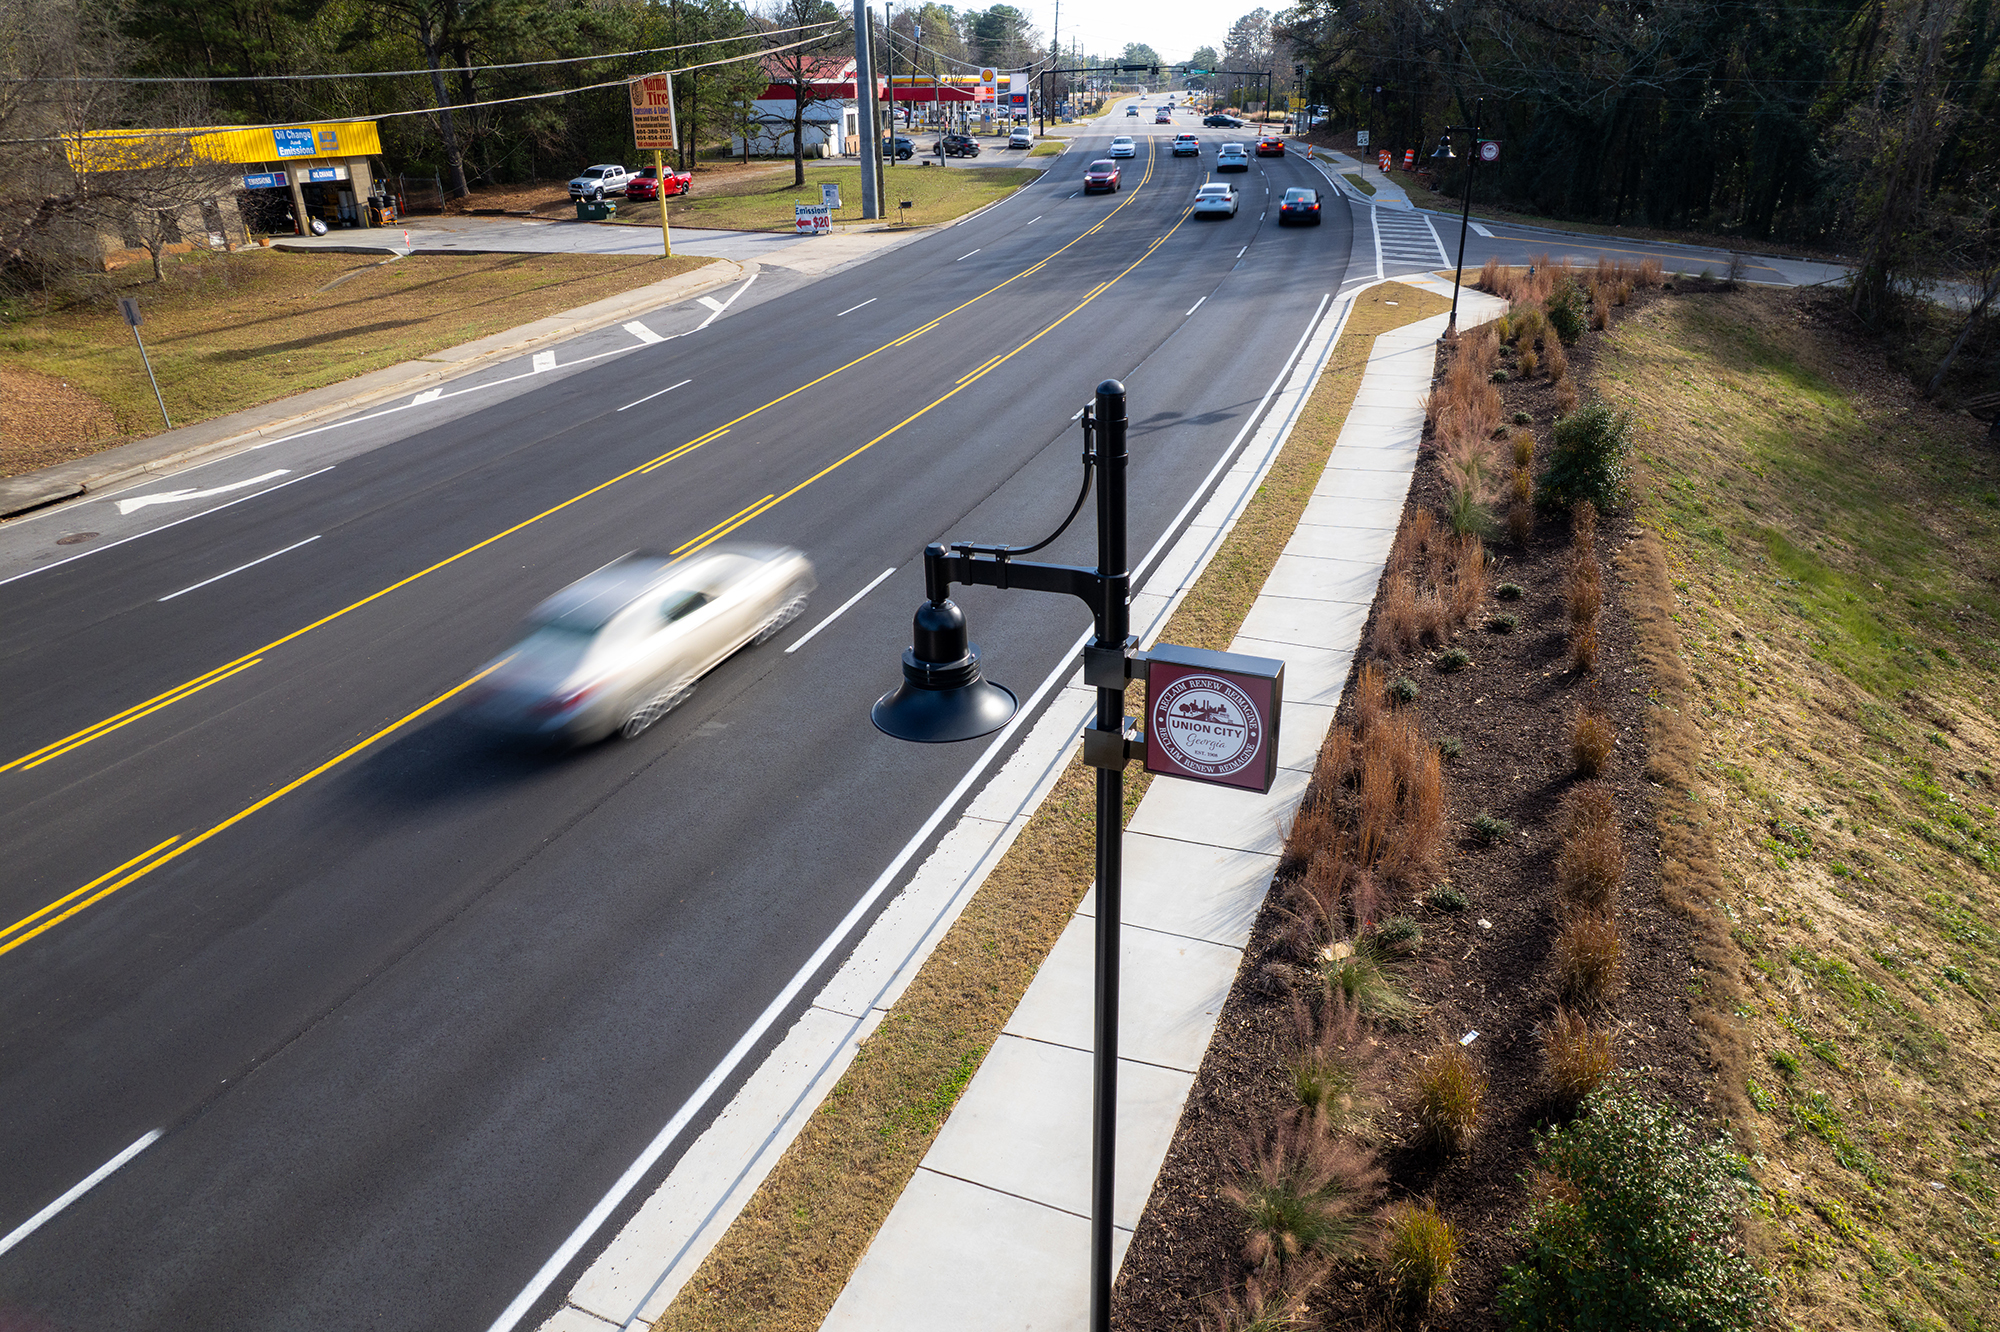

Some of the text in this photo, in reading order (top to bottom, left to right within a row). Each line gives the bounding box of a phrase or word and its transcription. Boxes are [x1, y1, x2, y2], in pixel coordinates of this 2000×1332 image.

[647, 92, 669, 105] Tire
[275, 130, 311, 141] Oil Change
[279, 146, 315, 156] Emissions
[795, 207, 828, 215] Emissions
[813, 216, 829, 230] $20
[1159, 679, 1257, 730] RECLAIM RENEW REIMAGINE
[1172, 720, 1243, 739] UNION CITY
[1186, 733, 1227, 751] Georgia
[1158, 727, 1256, 773] RECLAIM RENEW REIMAGINE
